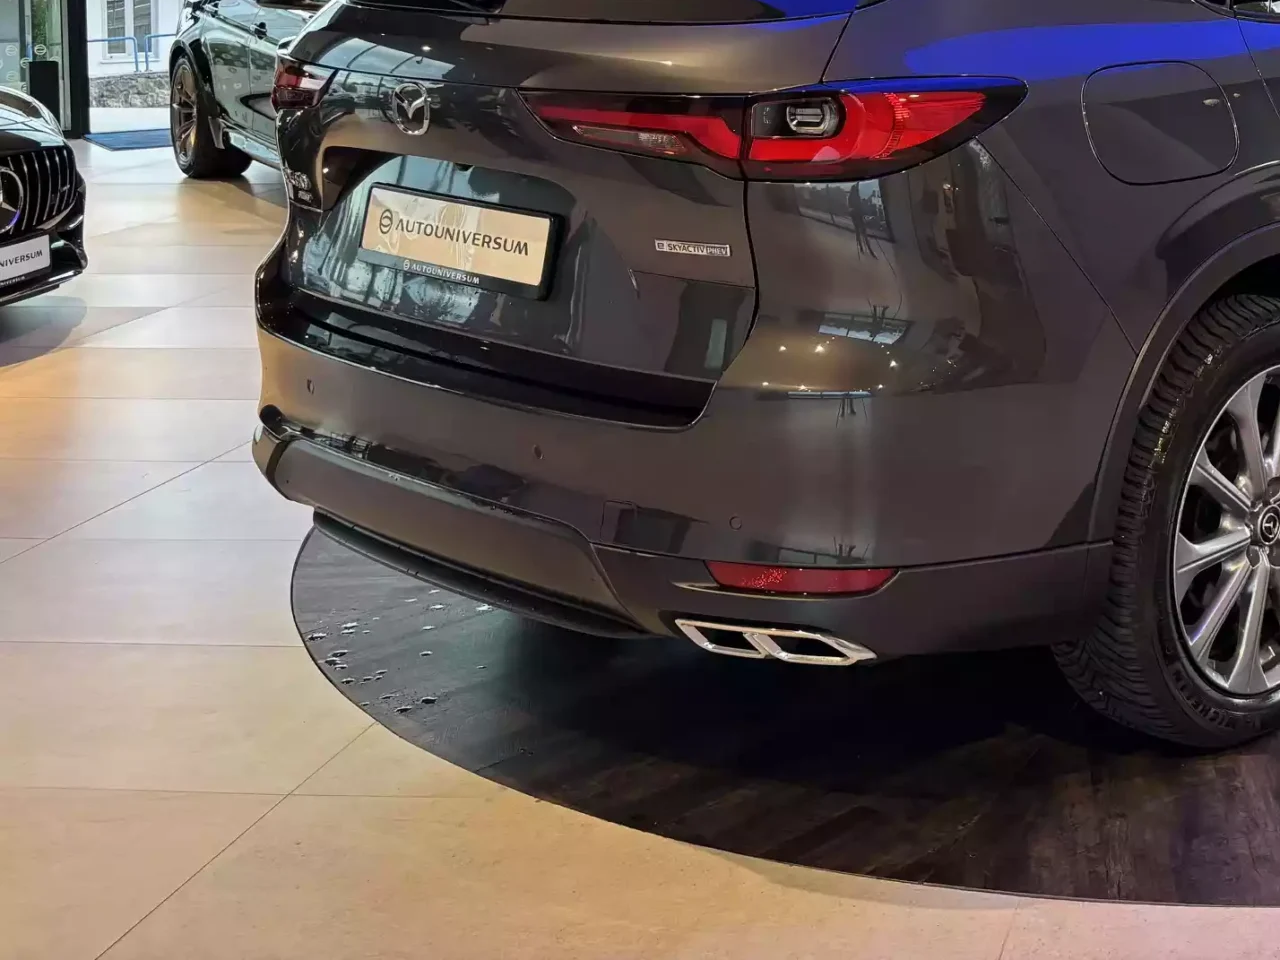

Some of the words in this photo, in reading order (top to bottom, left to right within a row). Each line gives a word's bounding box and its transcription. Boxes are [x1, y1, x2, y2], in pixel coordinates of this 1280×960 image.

[395, 221, 529, 256] AUTOUNIVERSUM
[667, 243, 705, 253] SKYACTIV
[411, 263, 480, 285] AUTOUNIVERSUM
